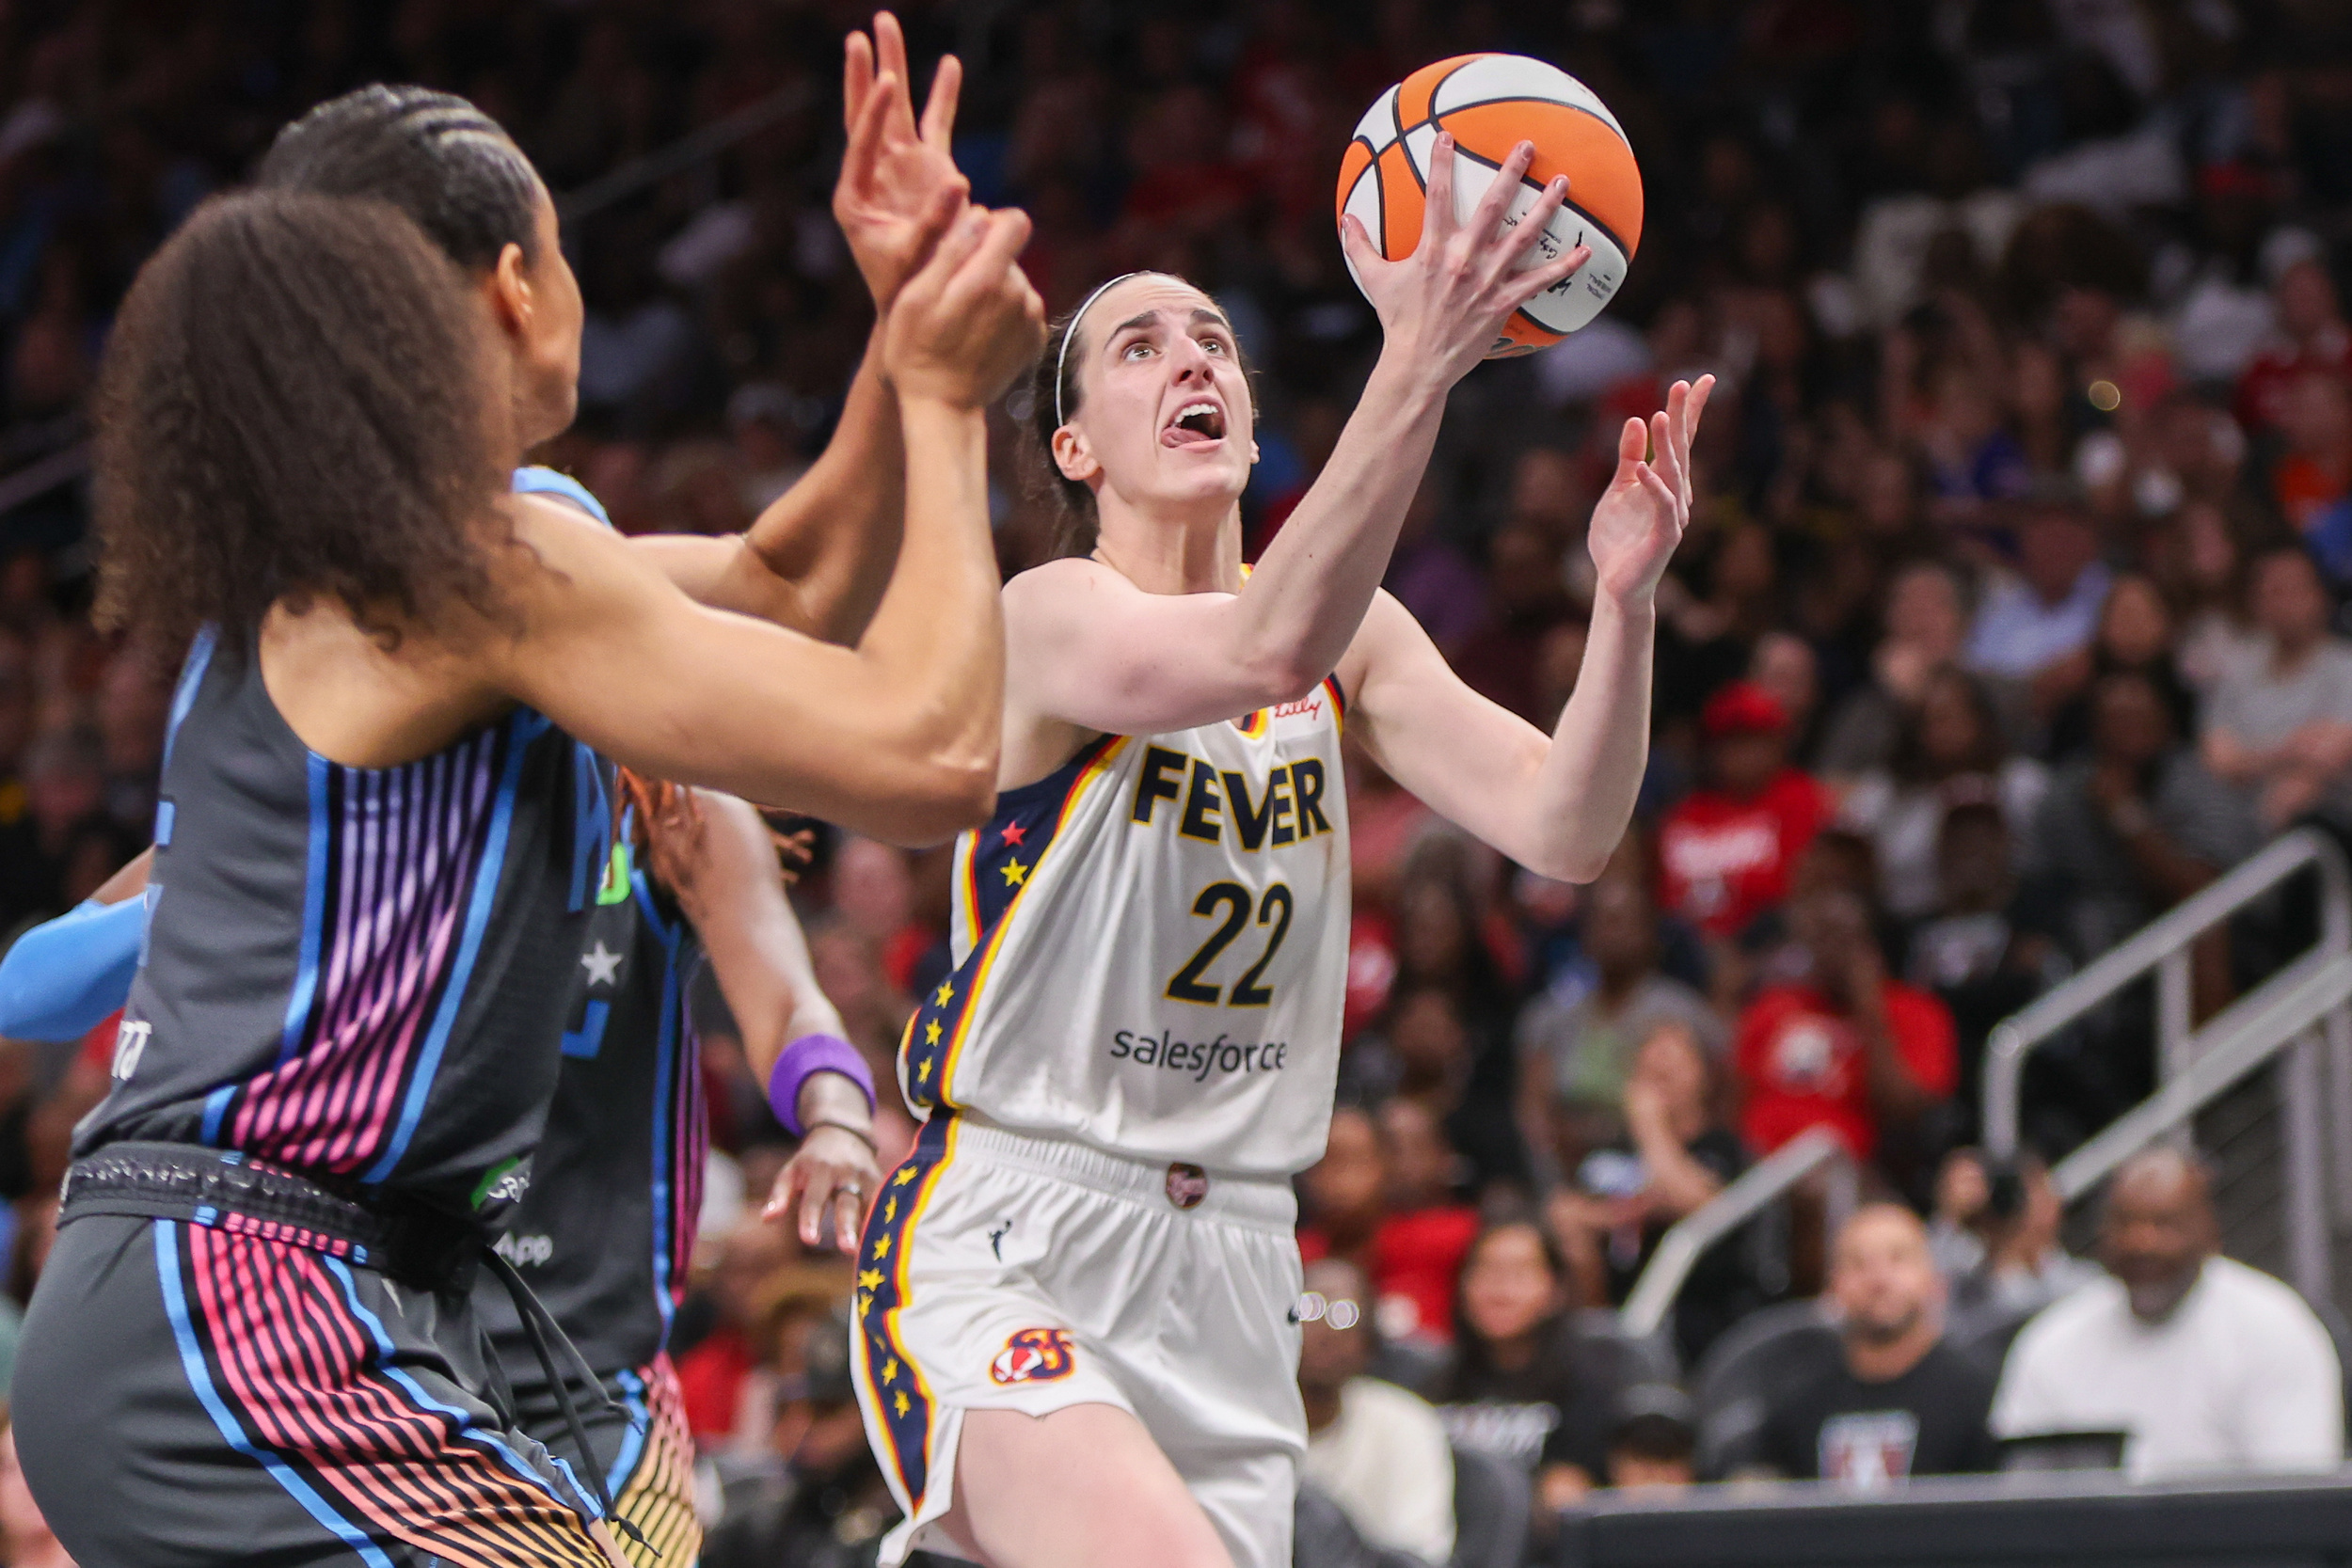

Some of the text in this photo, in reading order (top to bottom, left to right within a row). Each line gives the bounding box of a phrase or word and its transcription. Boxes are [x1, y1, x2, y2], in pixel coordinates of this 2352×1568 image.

[1132, 744, 1333, 852] FEVER
[1163, 881, 1293, 1008] 22
[1110, 1029, 1287, 1083] salesforce
